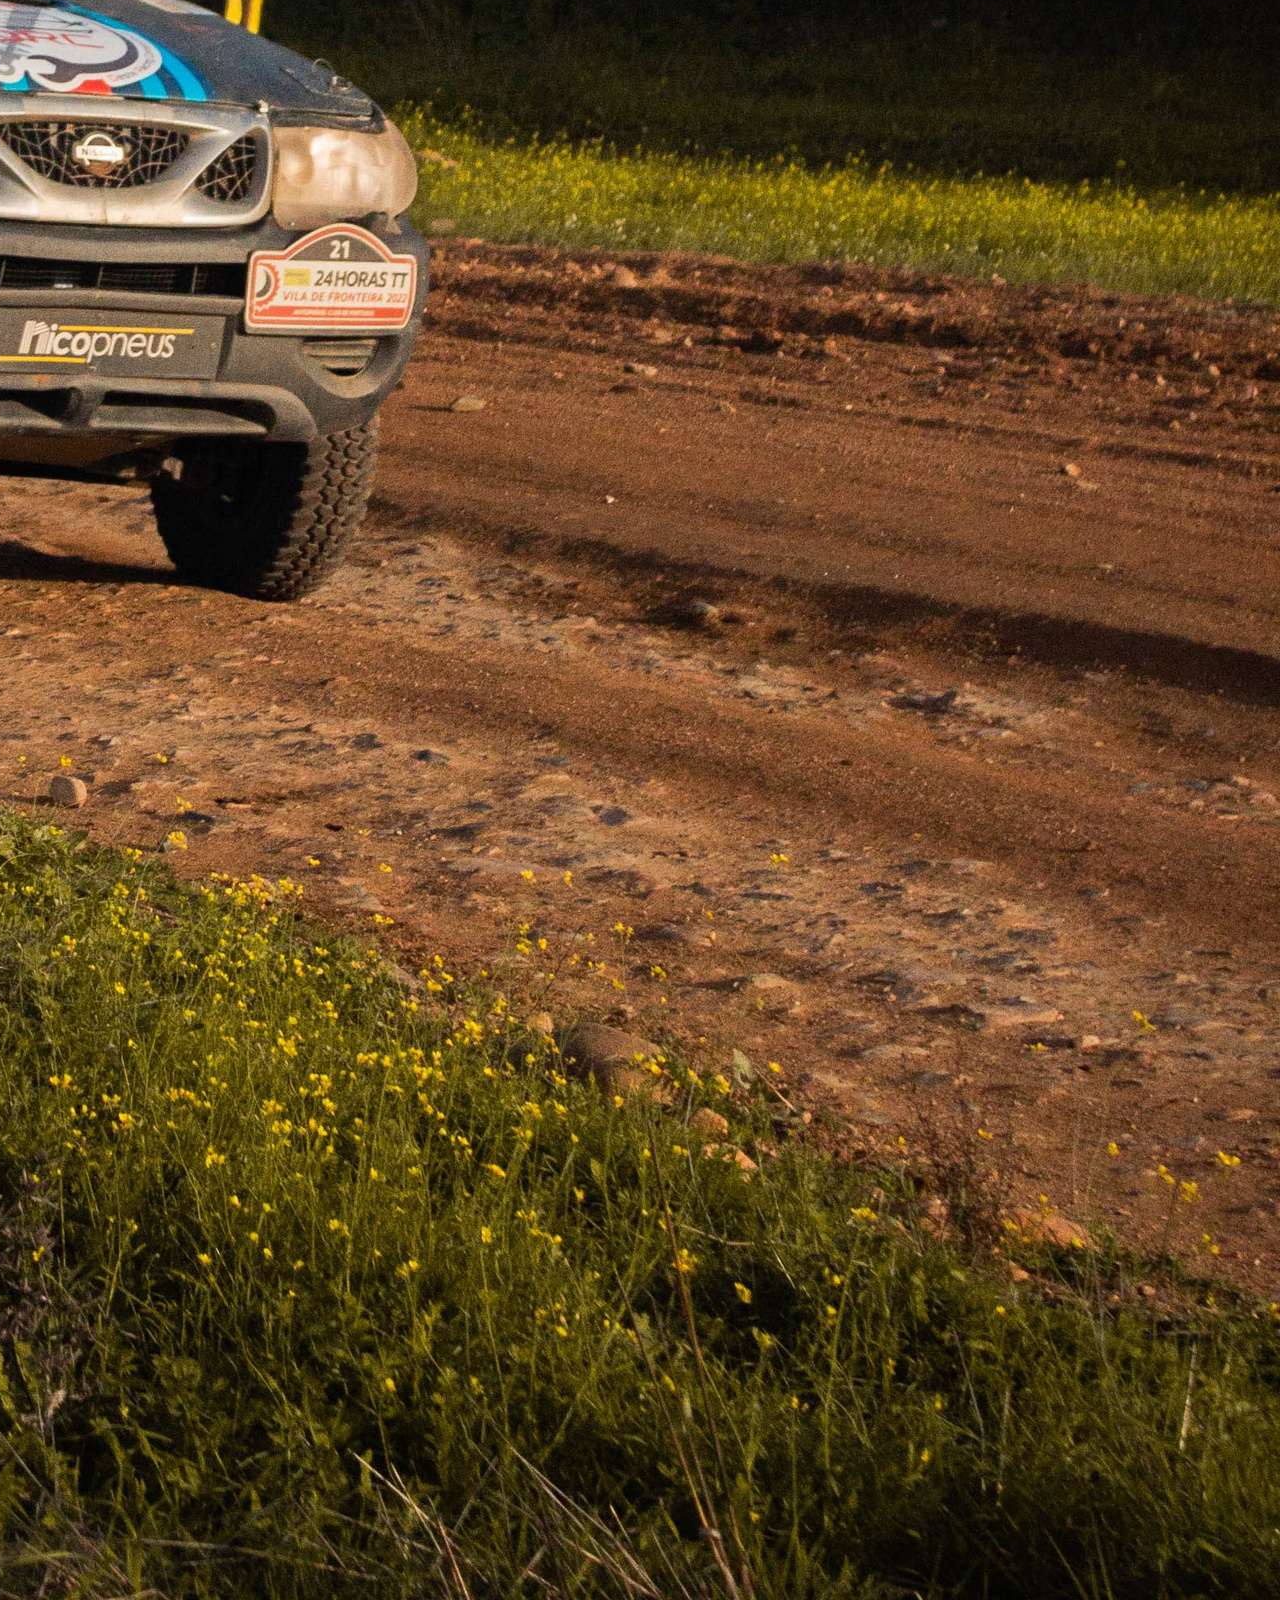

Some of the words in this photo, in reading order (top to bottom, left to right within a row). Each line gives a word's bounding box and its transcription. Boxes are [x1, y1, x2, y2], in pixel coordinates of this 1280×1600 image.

[330, 240, 351, 259] 21
[391, 272, 408, 288] TT
[283, 291, 308, 302] VILA
[311, 292, 326, 302] DE
[328, 292, 384, 303] FRONTEIRA
[387, 293, 408, 304] 2022
